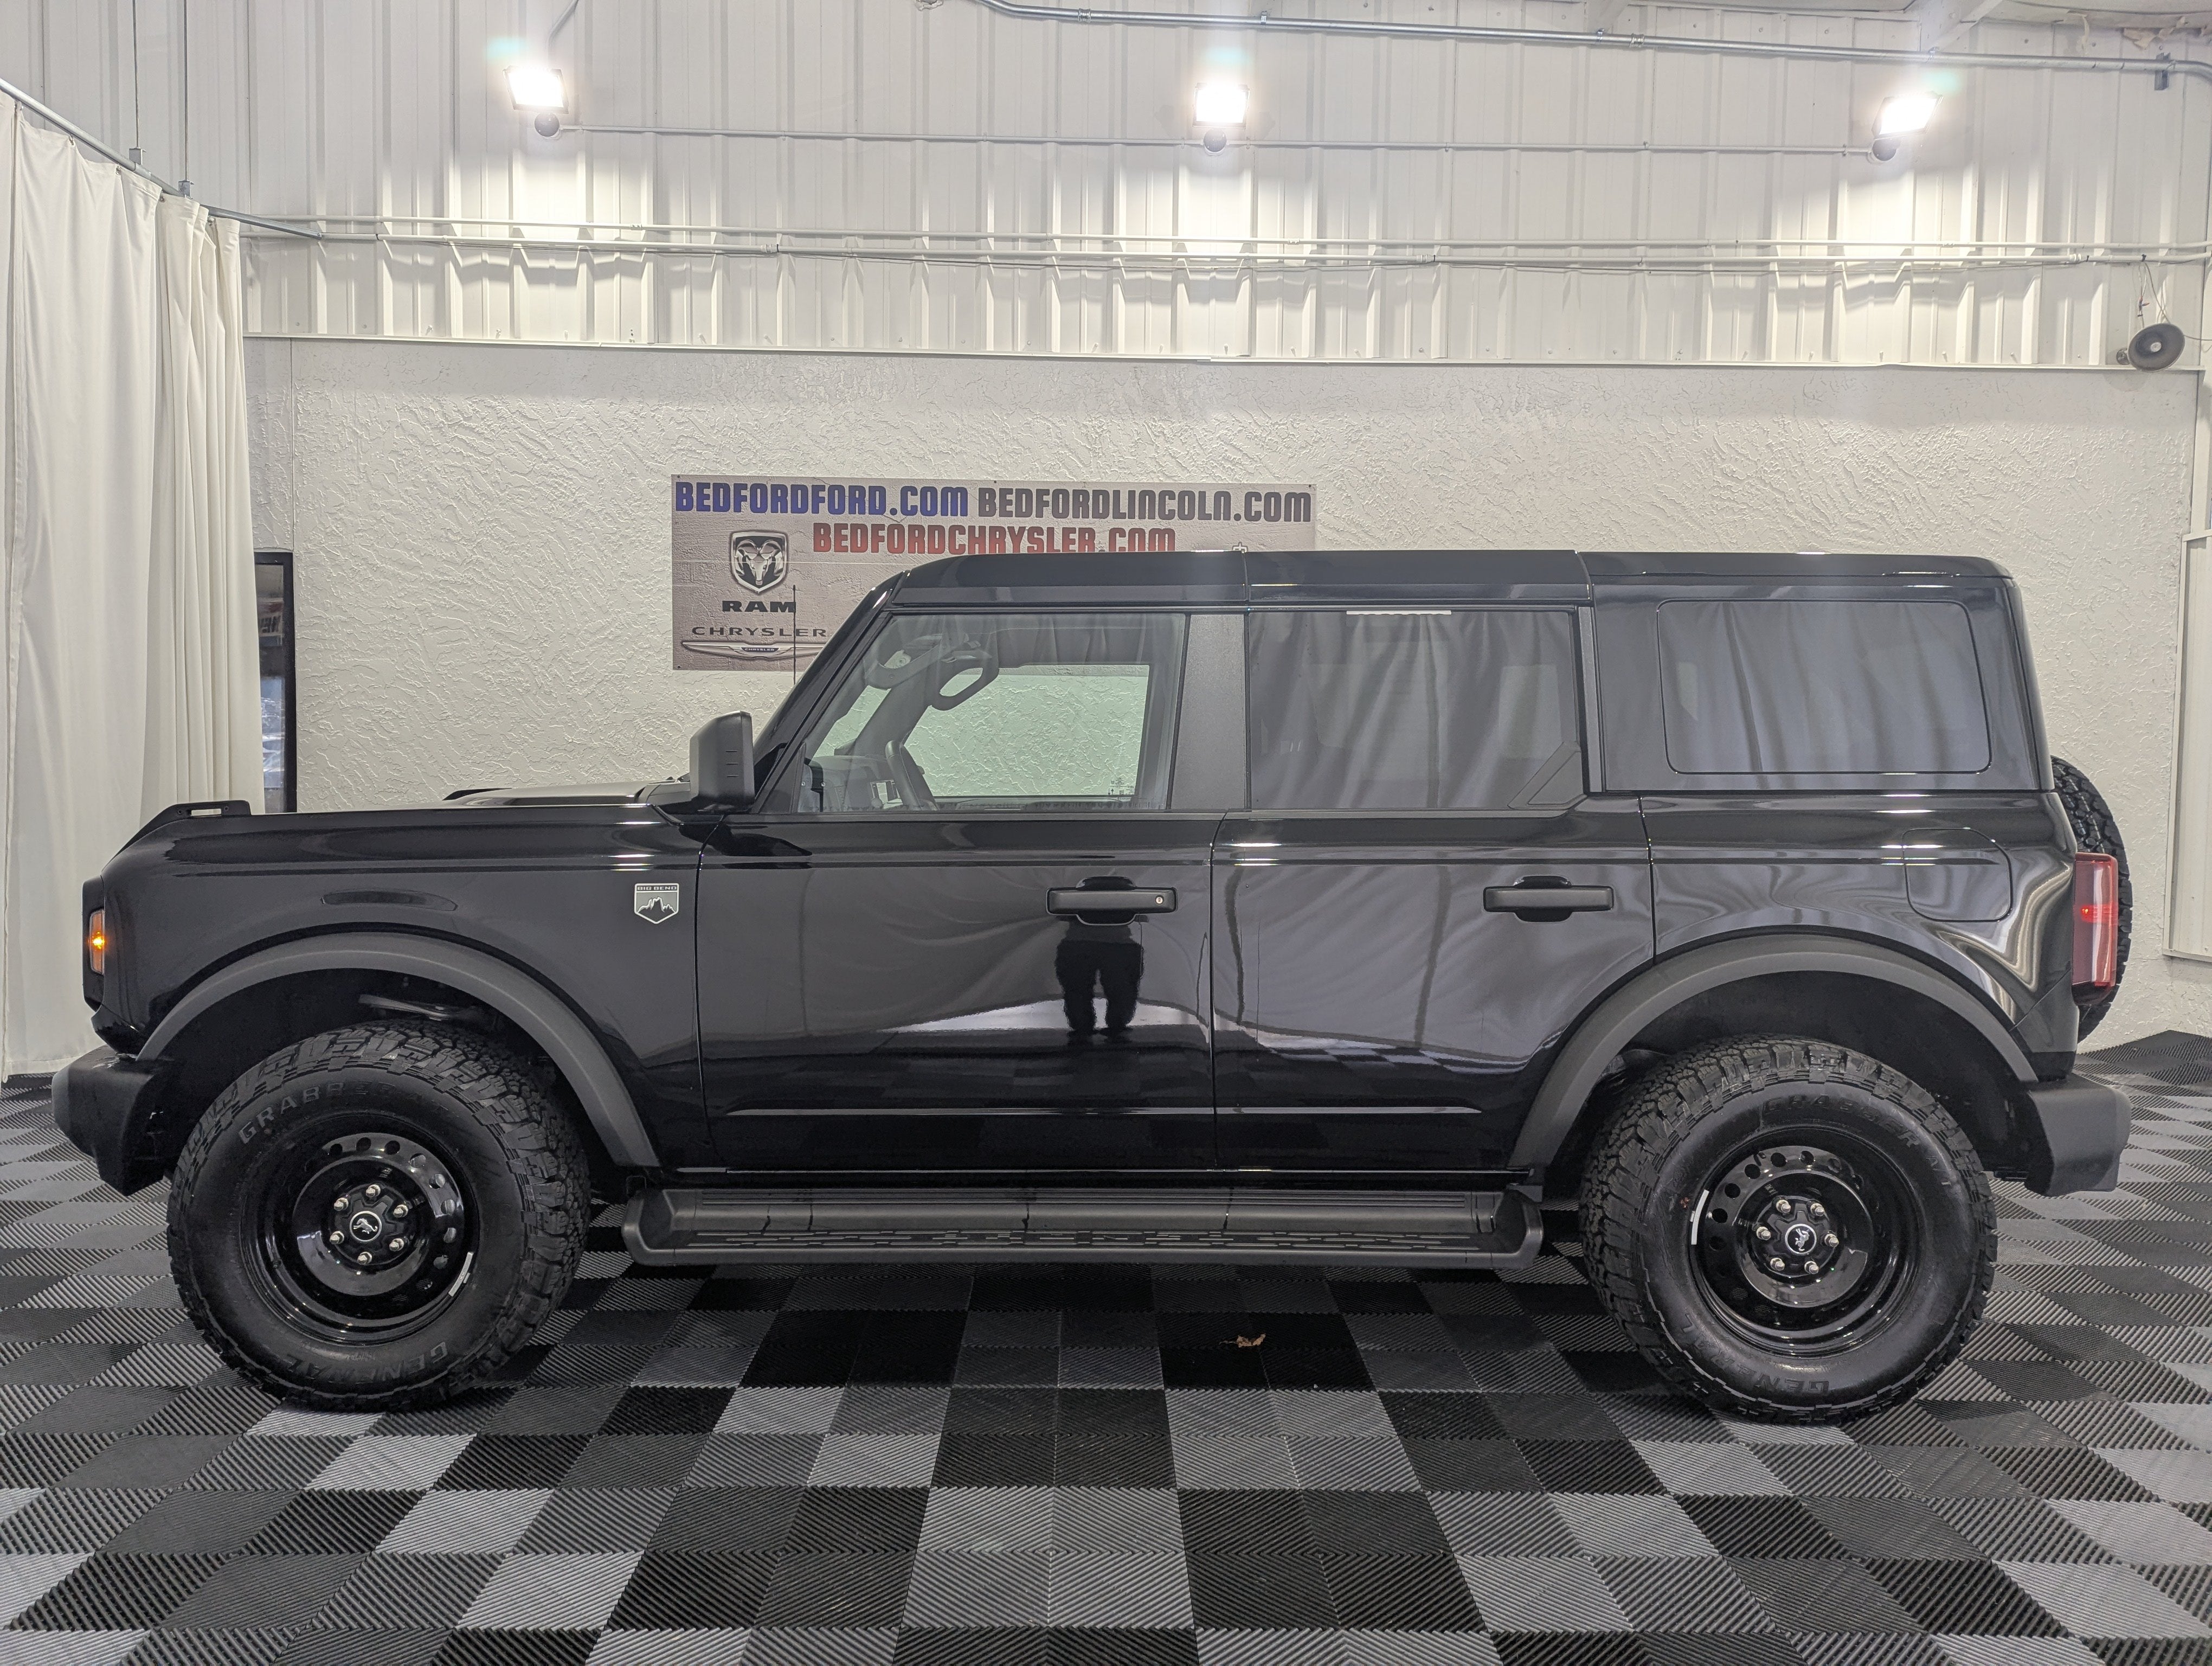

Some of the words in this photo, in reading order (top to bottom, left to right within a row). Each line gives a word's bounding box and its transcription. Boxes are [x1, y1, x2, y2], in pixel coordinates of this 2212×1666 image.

[676, 482, 968, 517] BEDFORDFORD.COM
[978, 488, 1312, 523] BEDFORDLINCOLN.COM
[813, 523, 1175, 554] BEDFORDCHRYSLER.COM
[722, 600, 796, 613] RAM
[692, 626, 827, 637] CHRYSLER
[1762, 1093, 1920, 1148] GRABBER
[1682, 1313, 1830, 1393] GENERAL
